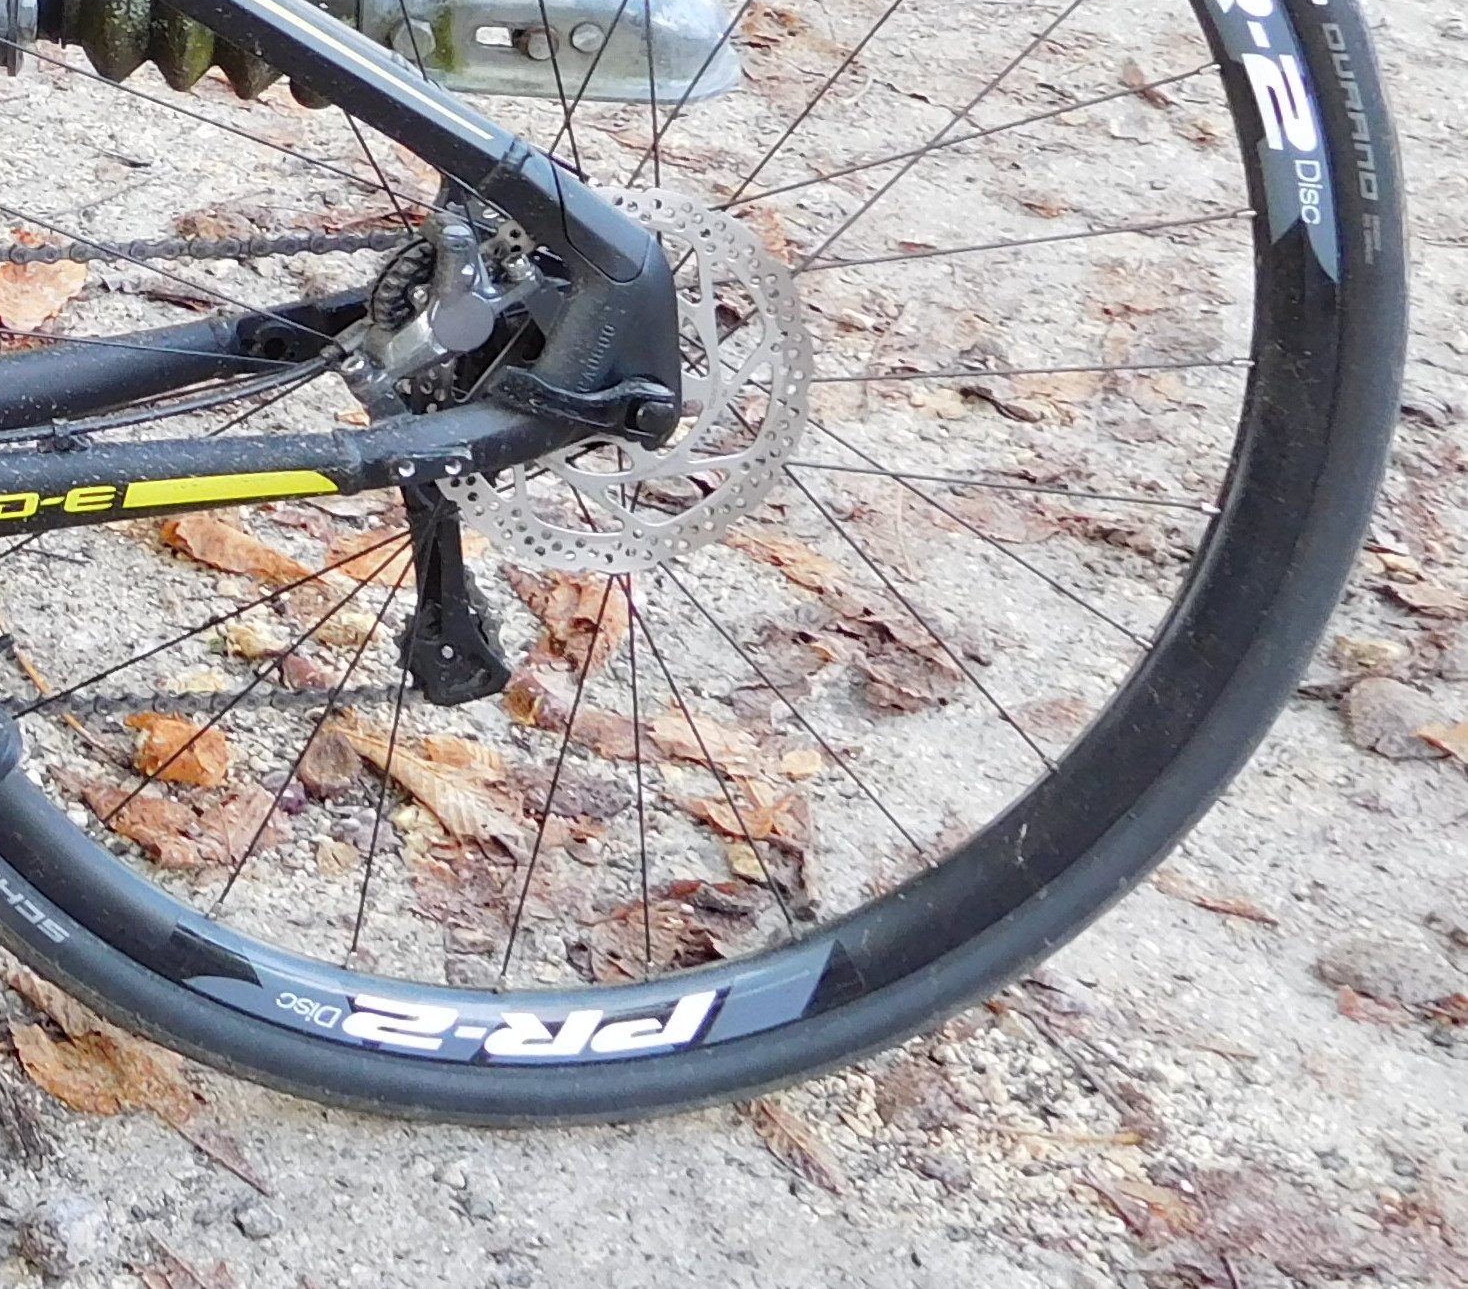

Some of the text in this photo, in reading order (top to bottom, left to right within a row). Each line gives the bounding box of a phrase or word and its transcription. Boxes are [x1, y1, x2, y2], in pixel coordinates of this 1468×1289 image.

[1323, 22, 1378, 201] DURANO
[1294, 158, 1321, 226] Disc
[276, 989, 720, 1058] PR-2 Disc
